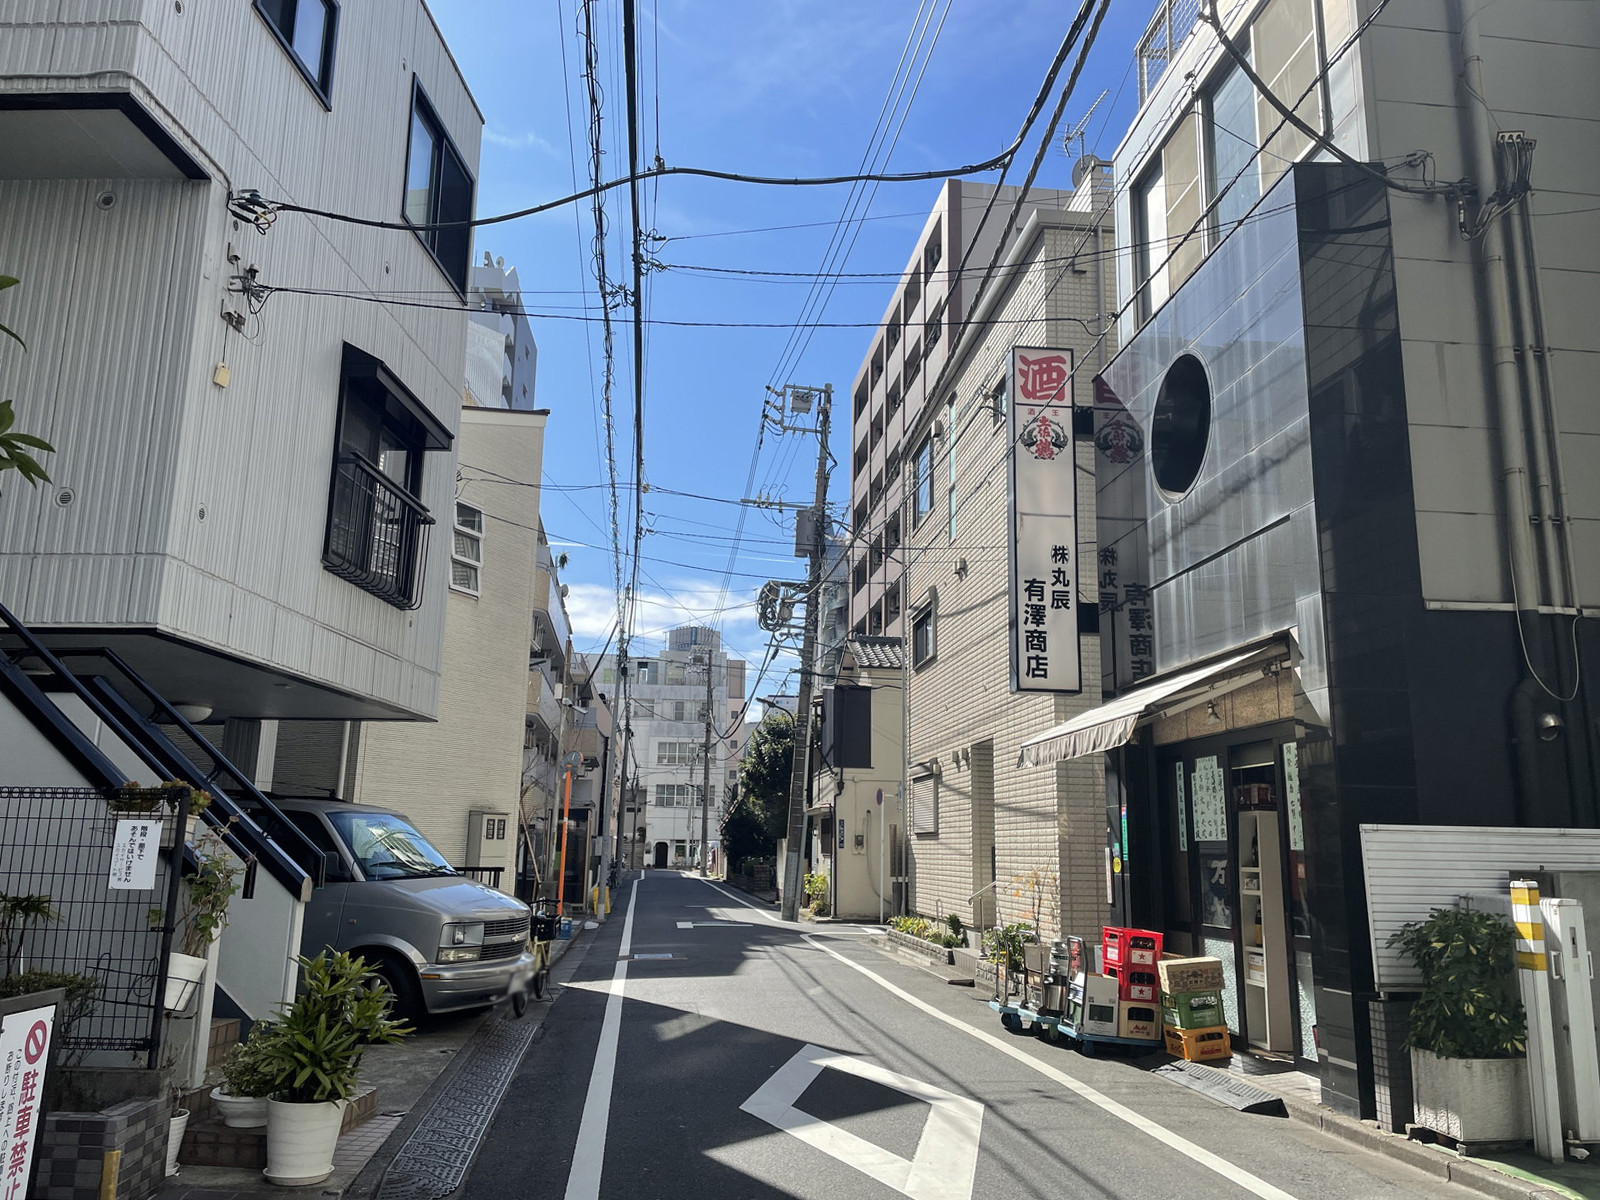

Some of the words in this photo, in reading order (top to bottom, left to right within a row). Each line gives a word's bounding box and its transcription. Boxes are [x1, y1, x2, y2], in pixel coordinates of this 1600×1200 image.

[1018, 354, 1067, 402] 酒
[1035, 416, 1054, 459] 土佐鶴
[1023, 578, 1048, 679] 有澤商店
[124, 826, 138, 883] あそんではいけません
[5, 1069, 39, 1200] 駐車禁止
